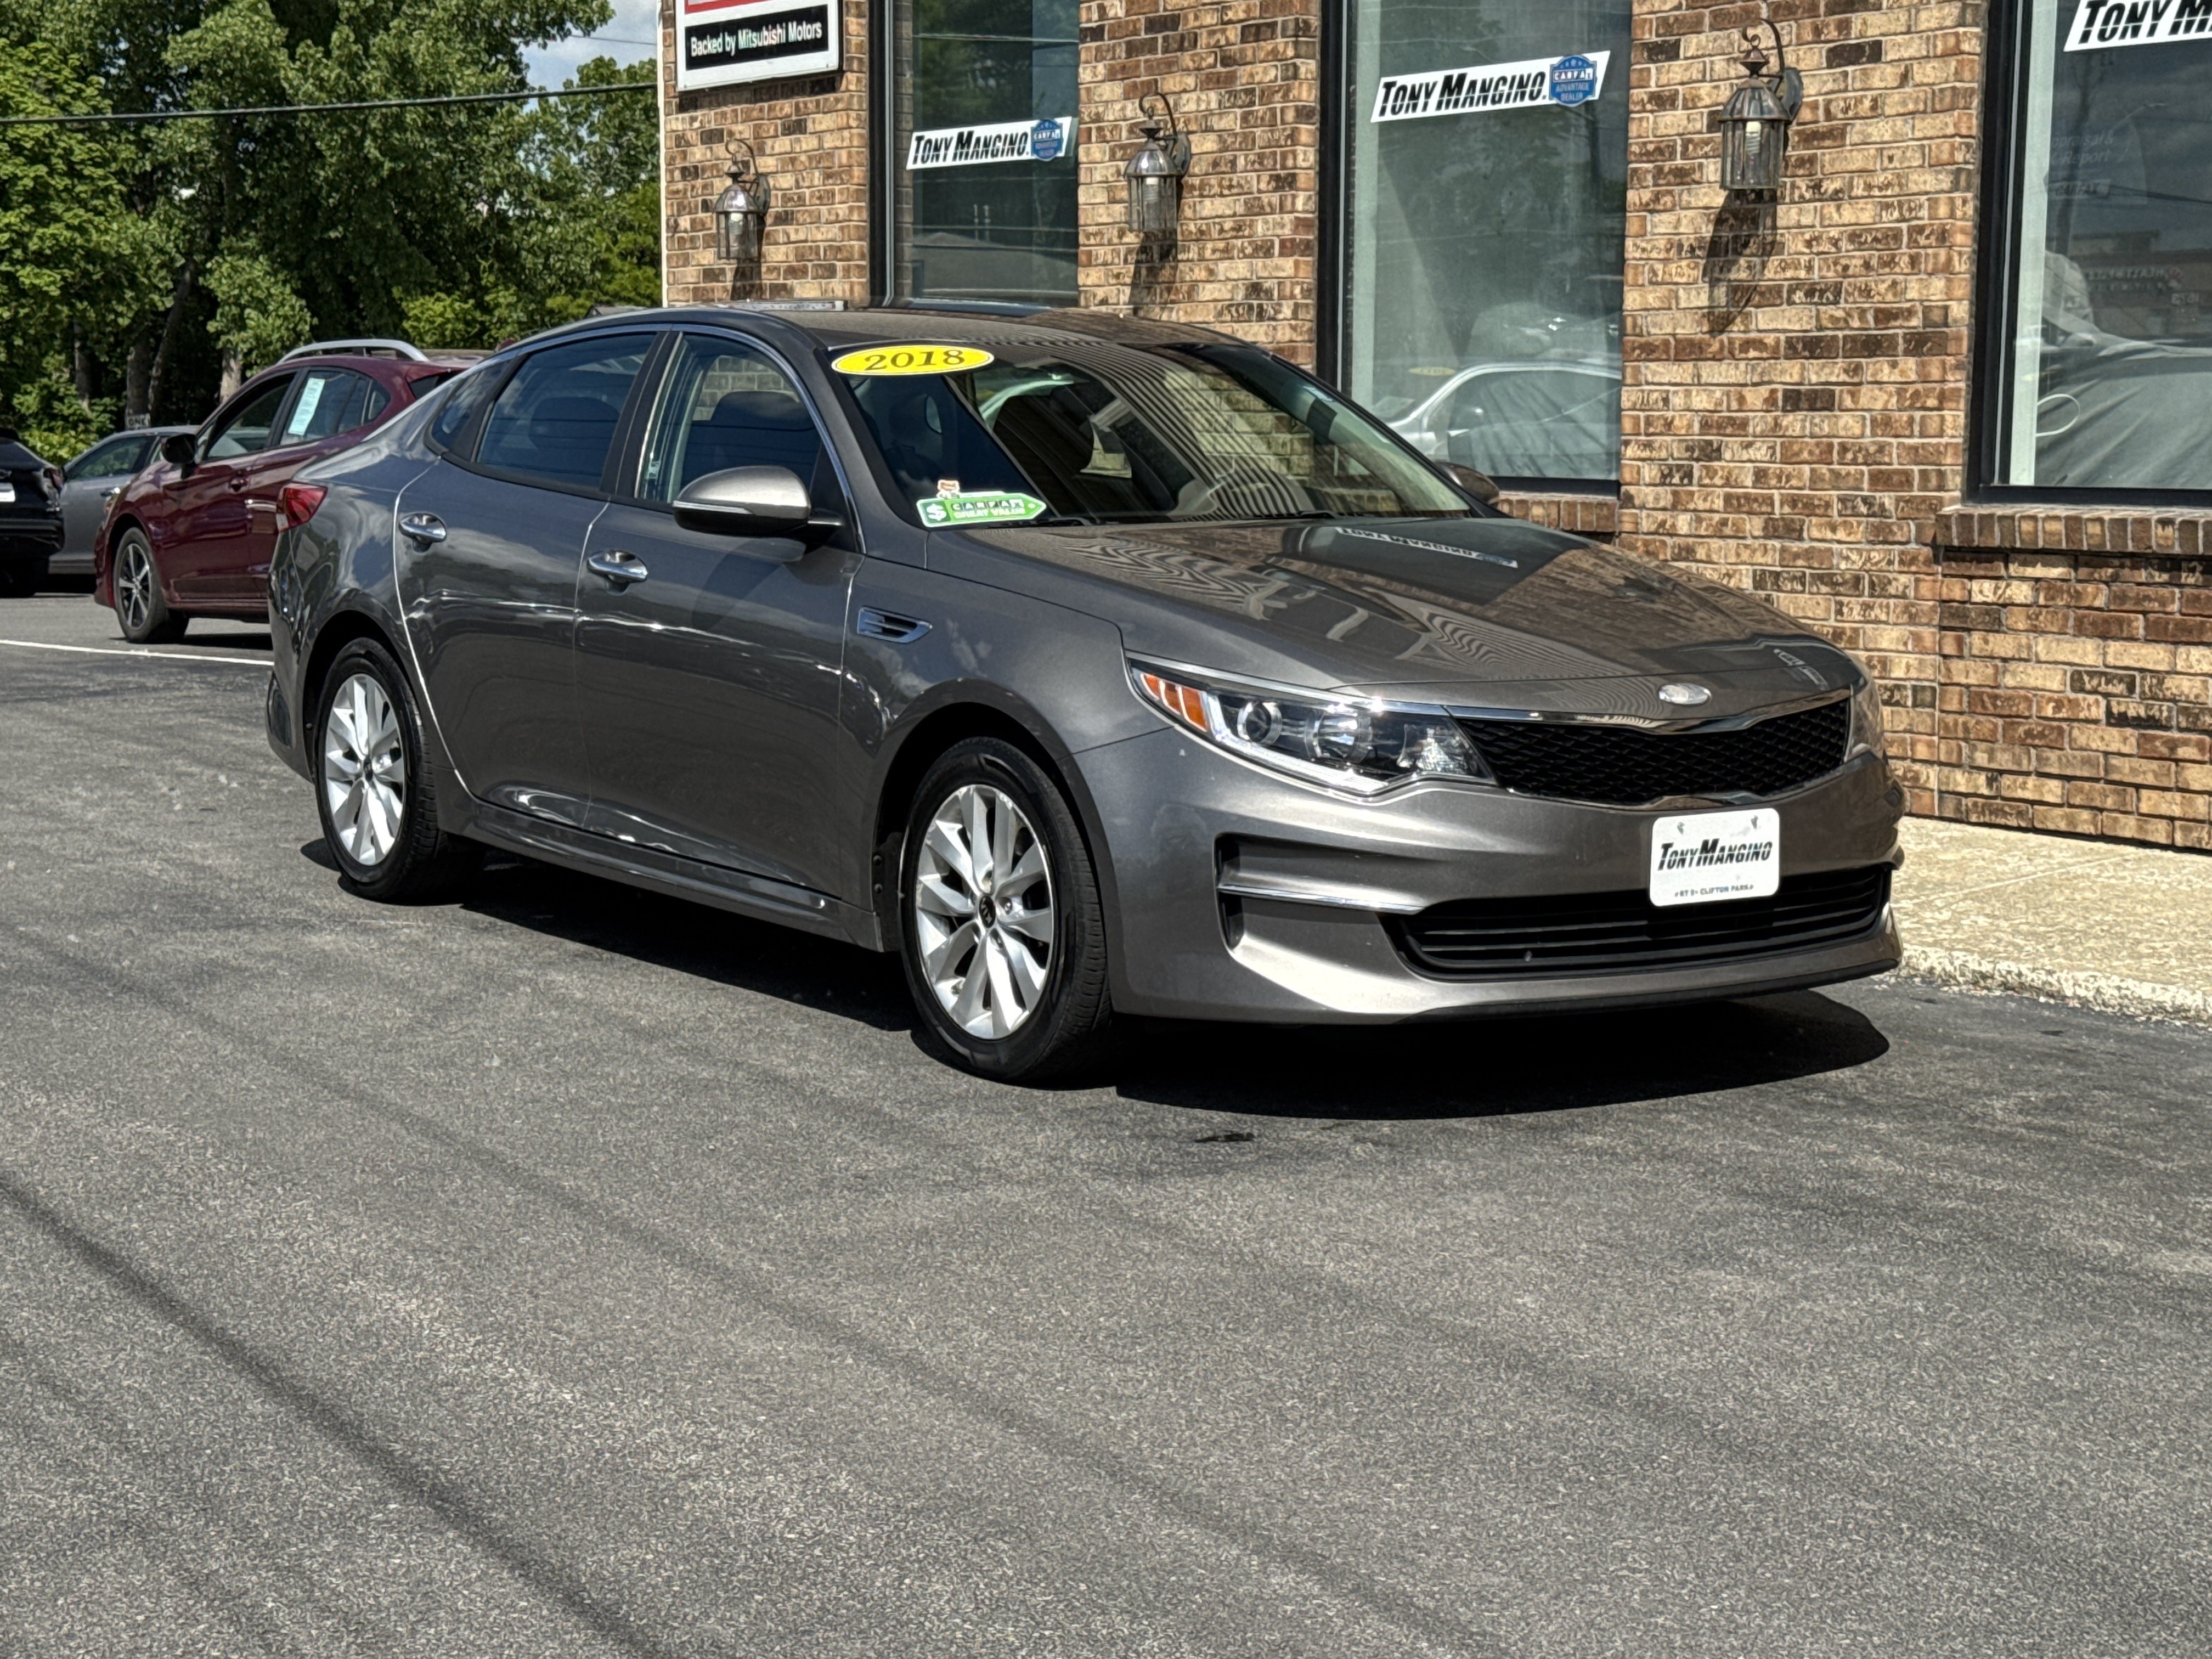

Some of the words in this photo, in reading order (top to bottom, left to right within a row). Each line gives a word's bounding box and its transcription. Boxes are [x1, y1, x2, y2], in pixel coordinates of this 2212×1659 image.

[2078, 0, 2170, 44] TONY
[690, 32, 723, 57] Backed
[724, 31, 736, 57] by
[738, 22, 786, 50] Mitsubishi
[788, 20, 822, 42] Motors
[1378, 80, 1438, 117] TONY
[1555, 81, 1590, 93] ADVANTAGE
[1560, 92, 1583, 102] DEALER
[912, 135, 953, 165] TONY
[864, 349, 966, 371] 2018
[1657, 842, 1699, 871] TONY
[1695, 838, 1774, 867] MANGINO
[1700, 885, 1729, 895] CLIFTON
